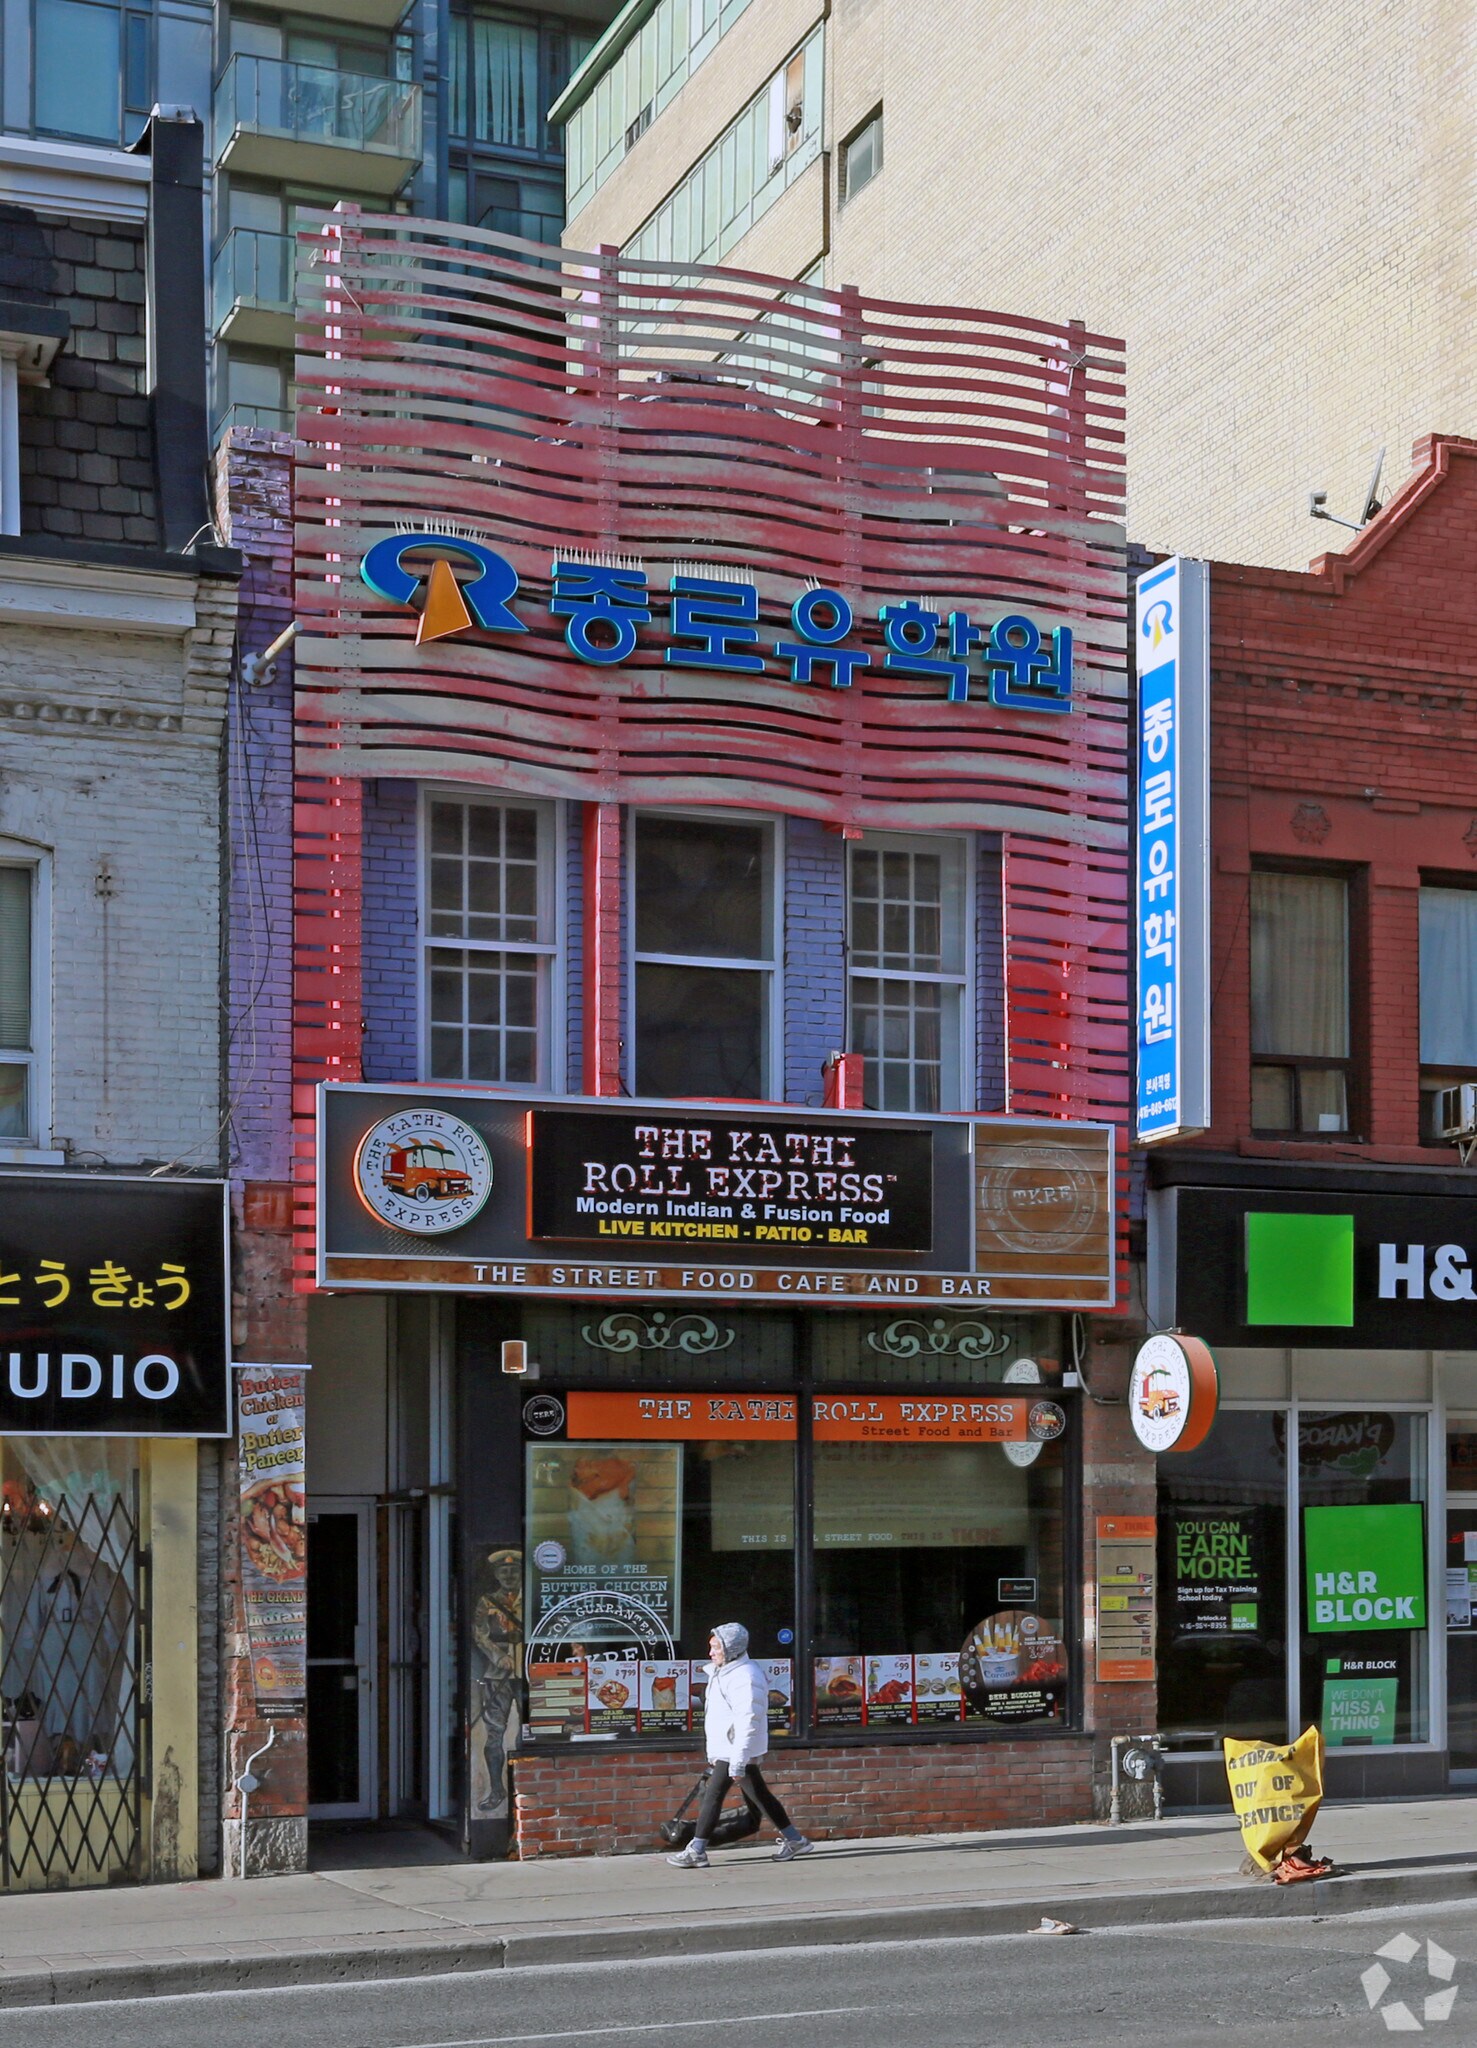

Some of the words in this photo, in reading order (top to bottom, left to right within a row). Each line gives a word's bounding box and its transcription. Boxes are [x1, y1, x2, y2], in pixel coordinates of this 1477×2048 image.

[549, 562, 1074, 715] 종로유학원
[1143, 698, 1176, 1045] 종로유학원
[1145, 1072, 1171, 1095] 본사직영
[366, 1138, 386, 1171] THE
[387, 1114, 445, 1136] KATHI
[452, 1125, 485, 1167] ROLL
[634, 1126, 712, 1160] THE
[728, 1132, 856, 1167] KATHI
[582, 1162, 691, 1195] ROLL
[706, 1167, 884, 1202] EXPRESS
[384, 1198, 473, 1226] EXPRESS
[576, 1197, 659, 1216] Modern
[666, 1201, 733, 1218] Indian
[741, 1203, 756, 1219] &
[764, 1204, 833, 1222] Fusion
[840, 1207, 890, 1224] Food
[599, 1220, 644, 1235] LIVE
[650, 1222, 738, 1239] KITCHEN
[755, 1225, 812, 1242] PATIO
[828, 1228, 868, 1243] BAR
[473, 1265, 527, 1282] THE
[552, 1268, 658, 1286] STREET
[682, 1271, 754, 1289] FOOD
[777, 1274, 845, 1292] CAFE
[867, 1277, 919, 1293] AND
[941, 1279, 992, 1295] BAR
[0, 1353, 179, 1400] UDIO
[241, 1374, 300, 1396] Butter
[241, 1393, 304, 1416] Chicken
[639, 1399, 692, 1419] THE
[708, 1400, 795, 1421] KATHI
[813, 1402, 884, 1422] ROLL
[899, 1403, 1014, 1423] EXPRESS
[266, 1414, 279, 1425] or
[243, 1426, 303, 1452] Butter
[861, 1426, 911, 1437] Street
[918, 1426, 950, 1437] Food
[958, 1426, 982, 1437] and
[990, 1427, 1013, 1437] Bar
[245, 1447, 303, 1472] Paneer
[741, 1535, 767, 1543] THIS
[774, 1535, 787, 1543] IS
[824, 1533, 862, 1542] STREET
[1176, 1522, 1206, 1534] YOU
[1209, 1522, 1240, 1534] CAN
[563, 1565, 596, 1575] HOME
[601, 1565, 618, 1575] OF
[623, 1564, 648, 1574] THE
[1177, 1557, 1258, 1579] MORE.
[540, 1582, 598, 1593] BUTTER
[604, 1581, 667, 1592] CHICKEN
[1315, 1571, 1377, 1595] H&R
[266, 1589, 304, 1604] GRAND
[617, 1594, 668, 1608] ROLL
[1316, 1597, 1415, 1623] BLOCK
[575, 1603, 658, 1646] GUARANTEED
[984, 1668, 1016, 1679] Corona
[1344, 1662, 1363, 1670] H&R
[1366, 1661, 1396, 1669] BLOCK
[1331, 1690, 1349, 1700] WE
[1351, 1689, 1383, 1700] DON'T
[1331, 1701, 1370, 1715] MISS
[1375, 1700, 1385, 1713] A
[1330, 1715, 1379, 1731] THING
[1272, 1775, 1295, 1791] OF
